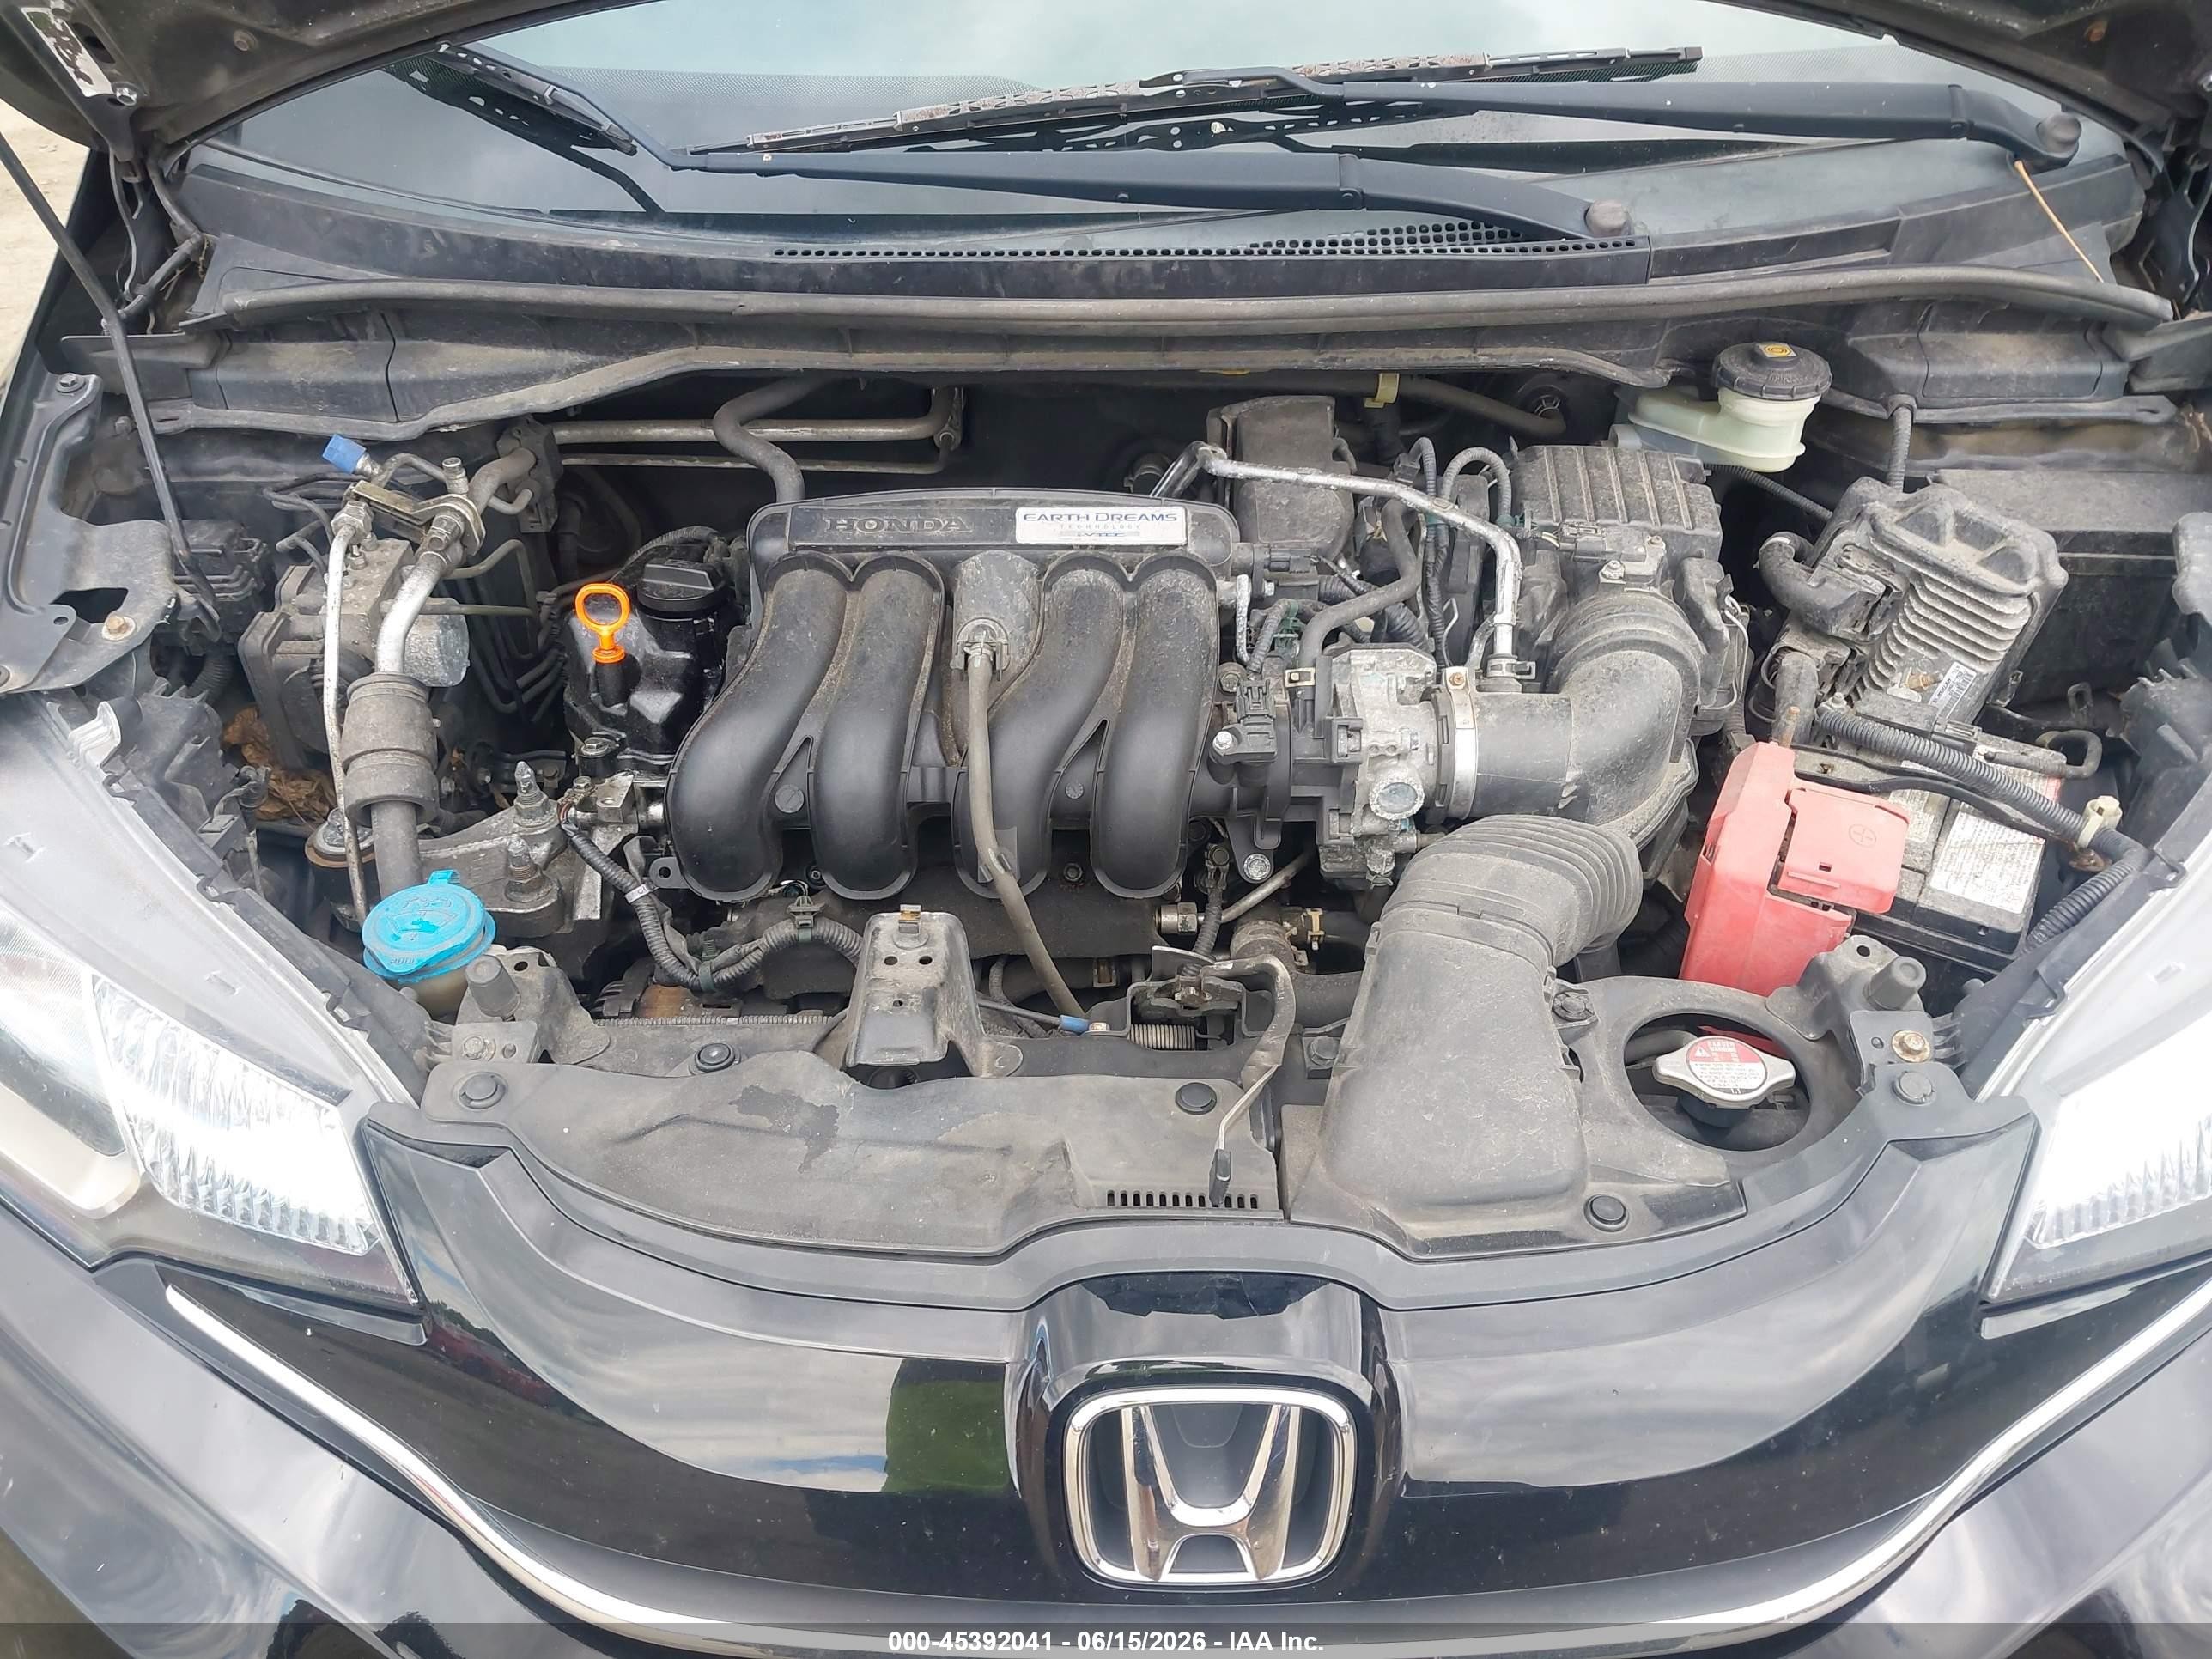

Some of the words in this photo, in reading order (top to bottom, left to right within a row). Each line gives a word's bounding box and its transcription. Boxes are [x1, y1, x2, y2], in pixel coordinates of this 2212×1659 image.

[1023, 513, 1090, 522] EARTH
[1095, 512, 1177, 522] DREAMS
[823, 516, 975, 534] HONDA
